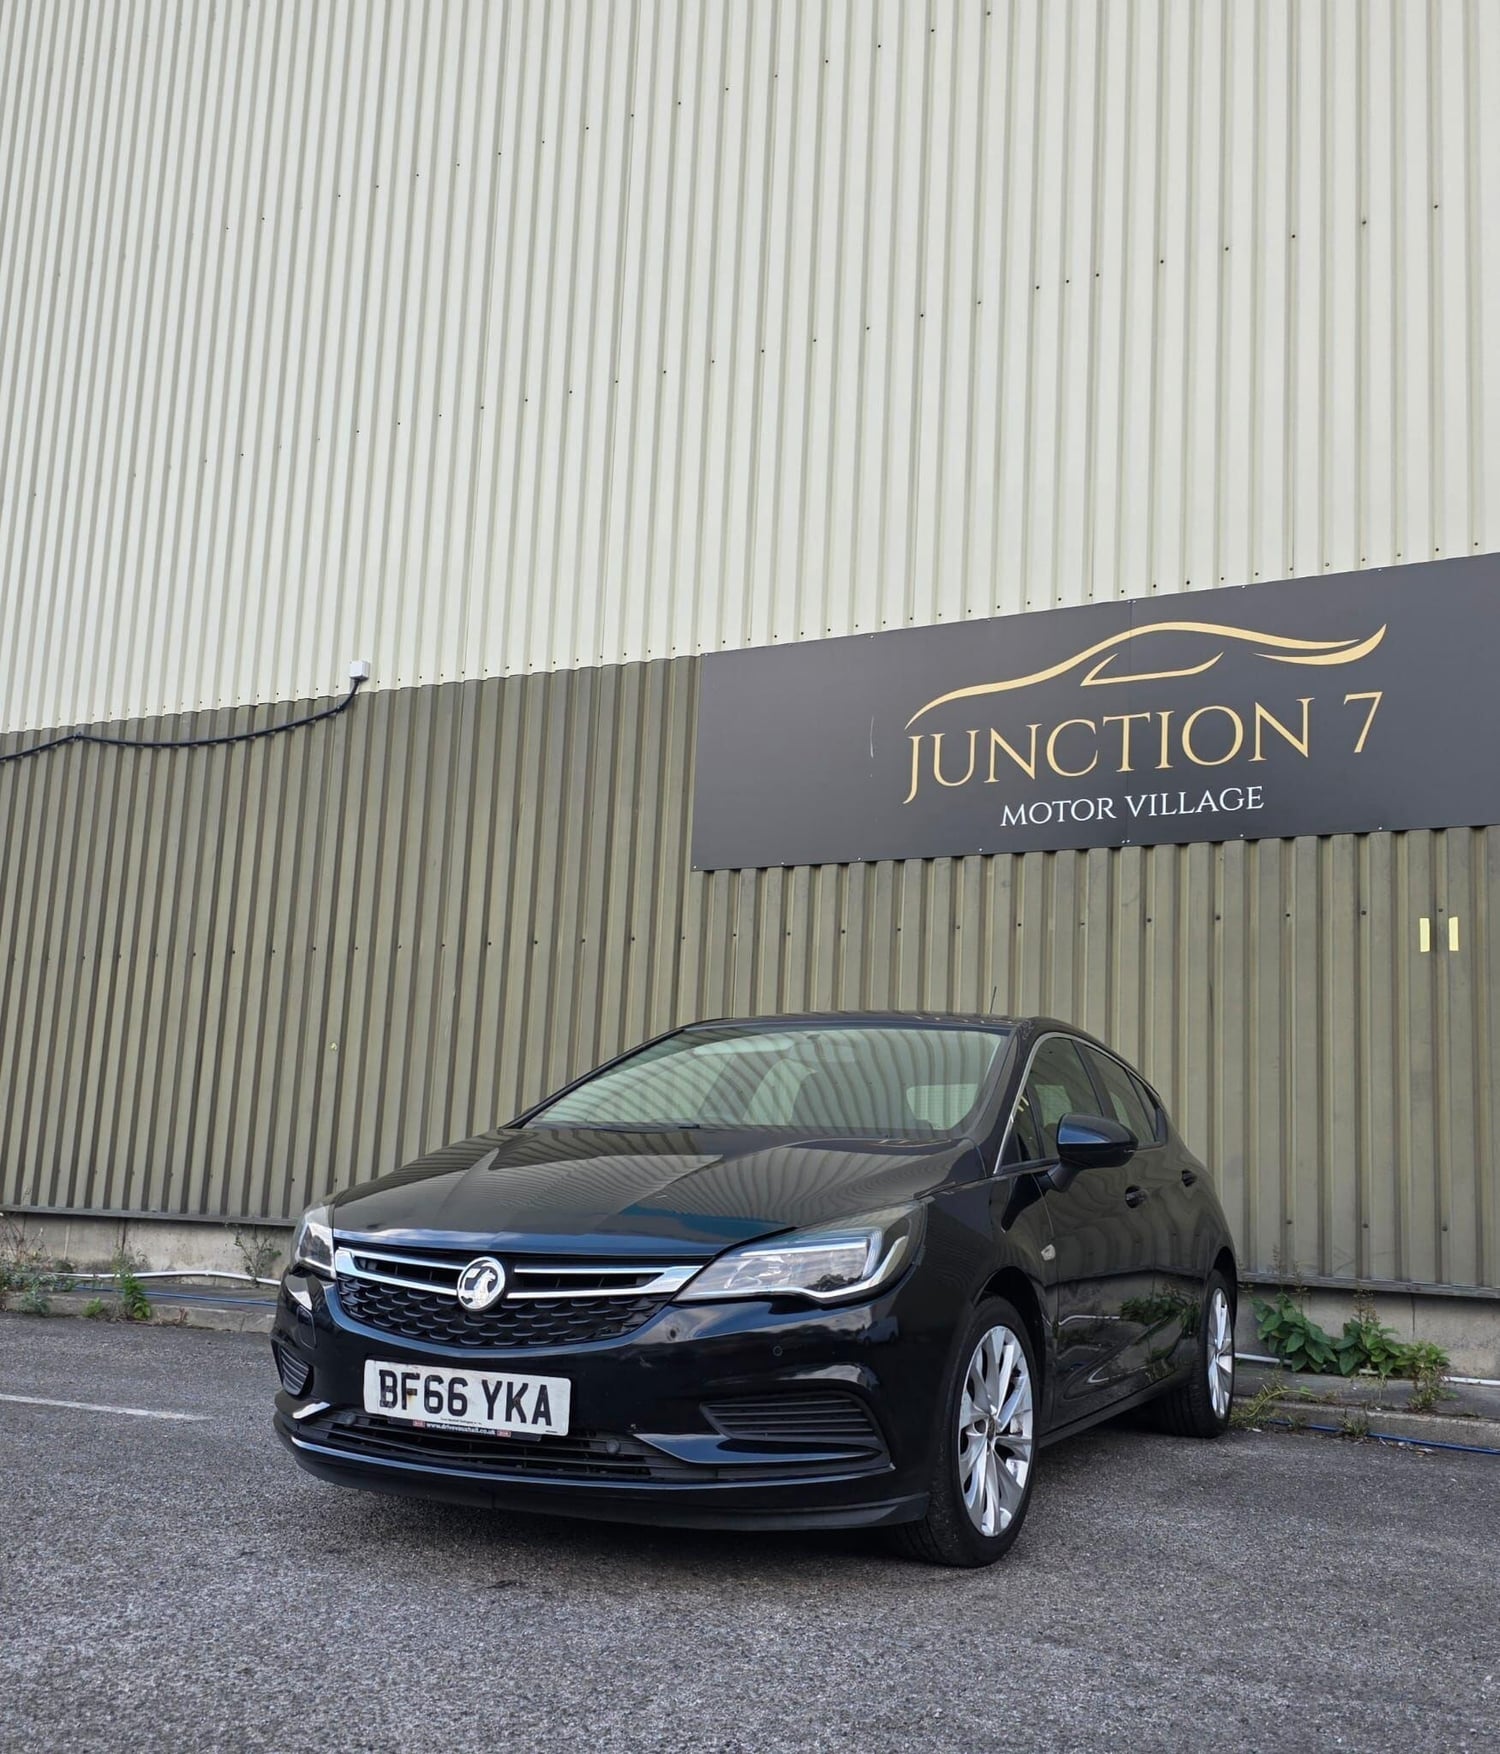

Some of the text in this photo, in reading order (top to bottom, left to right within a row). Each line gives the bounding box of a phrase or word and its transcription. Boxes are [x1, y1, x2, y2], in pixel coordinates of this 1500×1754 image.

[903, 691, 1384, 804] JUNCTION 7
[1000, 785, 1265, 827] MOTOR VILLAGE
[379, 1369, 552, 1427] BF66 YKA
